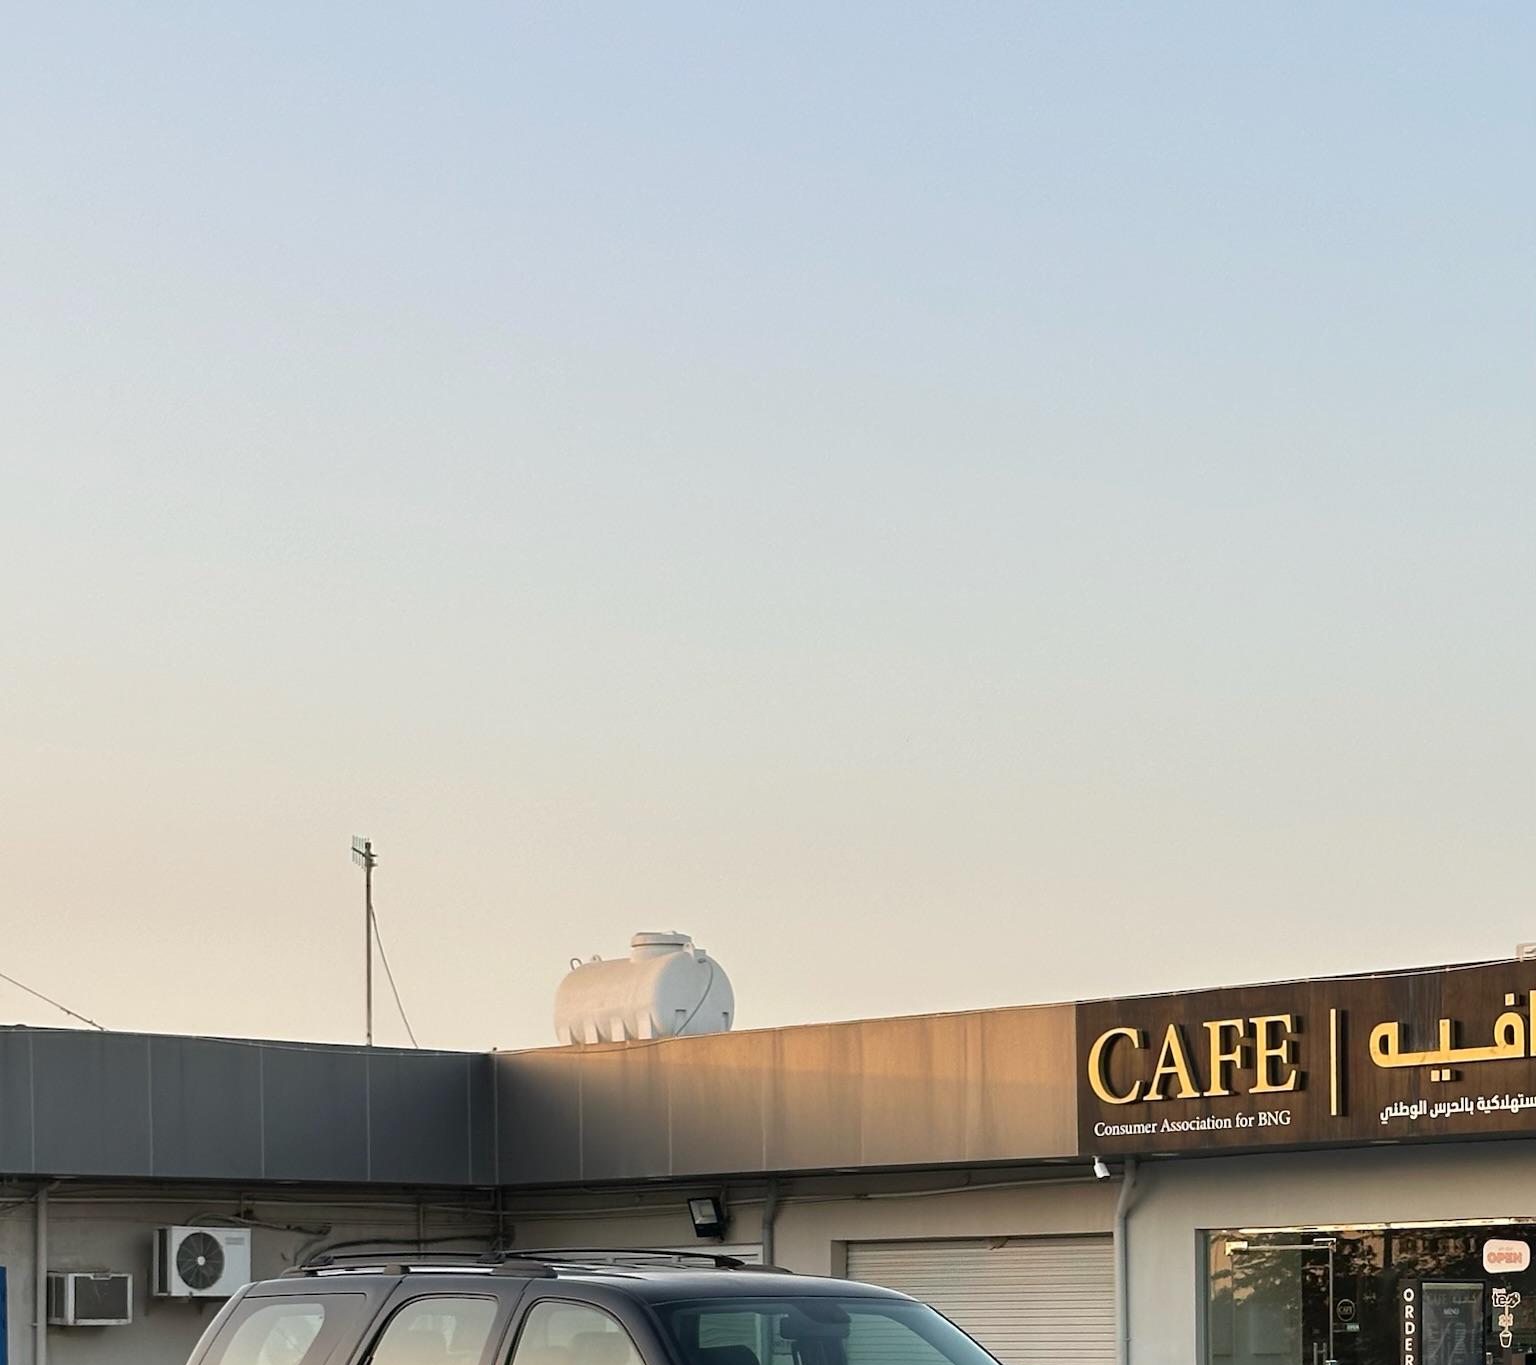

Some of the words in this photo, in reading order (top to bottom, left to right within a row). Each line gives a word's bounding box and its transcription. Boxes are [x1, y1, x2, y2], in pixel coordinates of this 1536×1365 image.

[1088, 1013, 1297, 1105] CAFE
[1379, 1099, 1427, 1125] الوطني
[1429, 1096, 1474, 1118] بالحرس
[1094, 1121, 1158, 1137] Consumer
[1160, 1115, 1233, 1133] Association
[1235, 1112, 1255, 1128] for
[1257, 1110, 1291, 1127] BNG
[1487, 1251, 1523, 1264] OPEN
